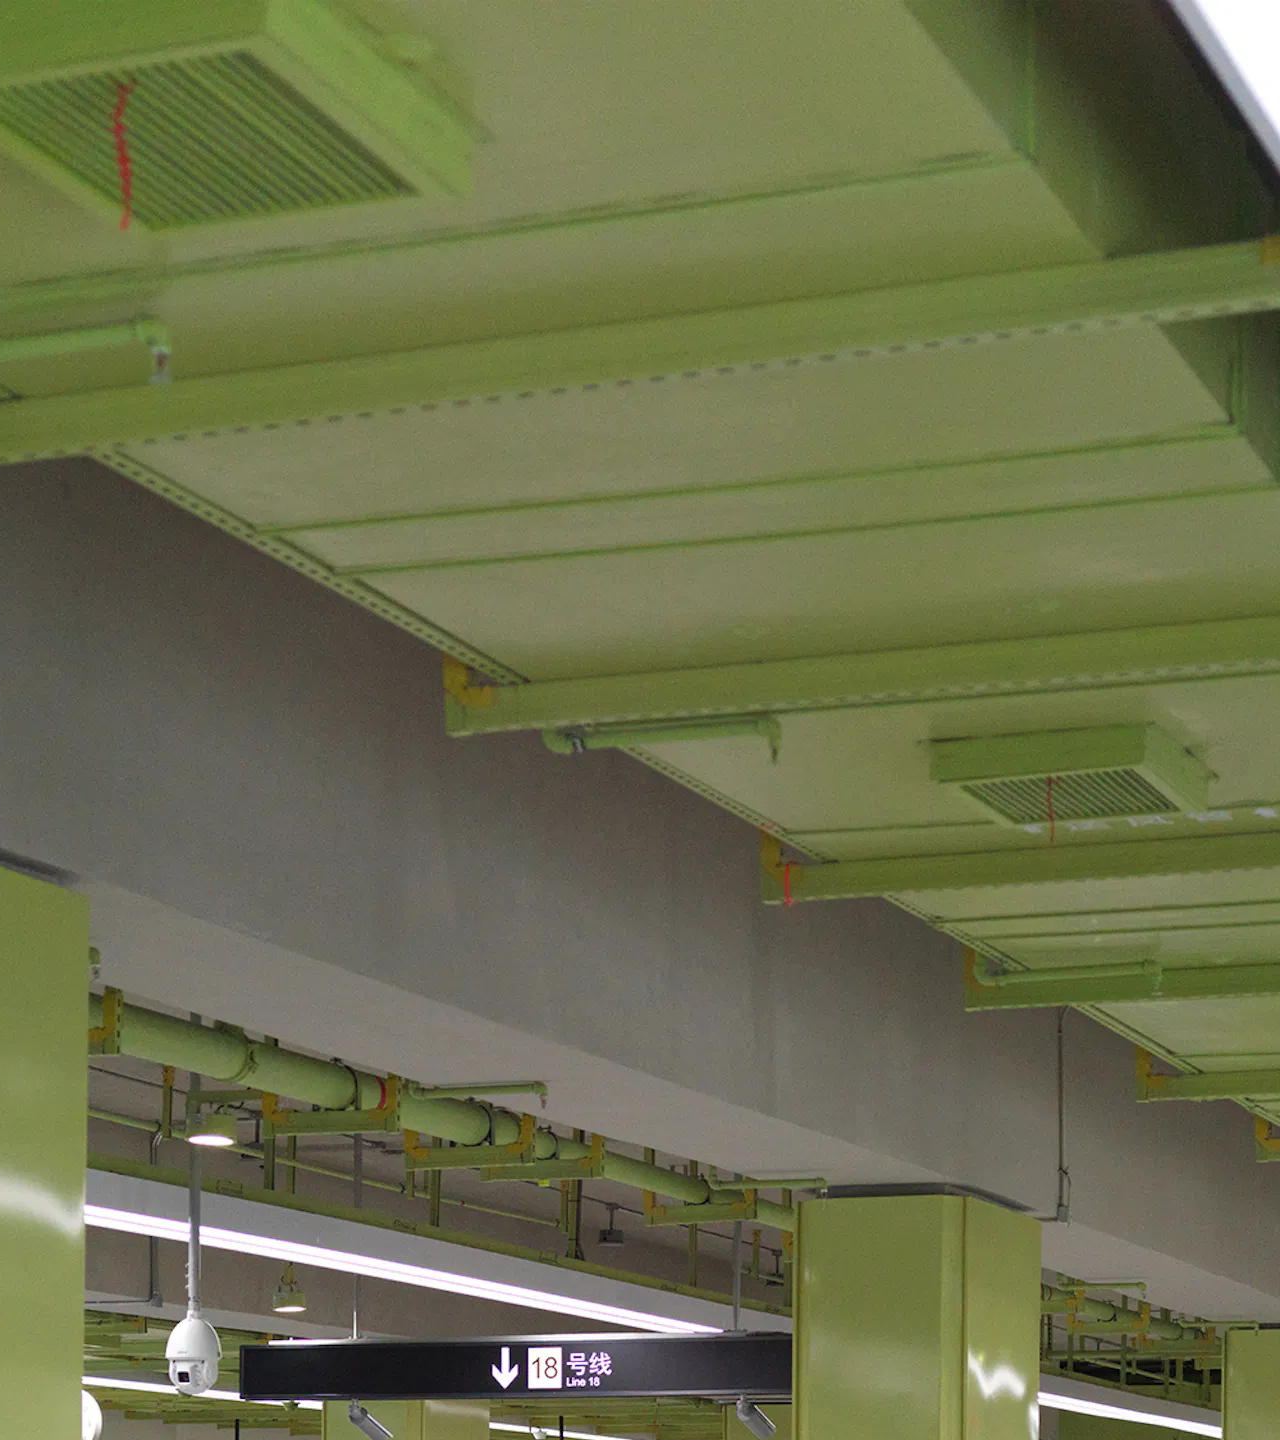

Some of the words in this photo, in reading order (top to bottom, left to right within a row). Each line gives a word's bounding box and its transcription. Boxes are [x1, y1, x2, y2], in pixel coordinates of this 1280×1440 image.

[531, 1357, 558, 1379] 18
[566, 1352, 612, 1376] 号线
[566, 1376, 586, 1388] Line
[588, 1376, 600, 1387] 18
